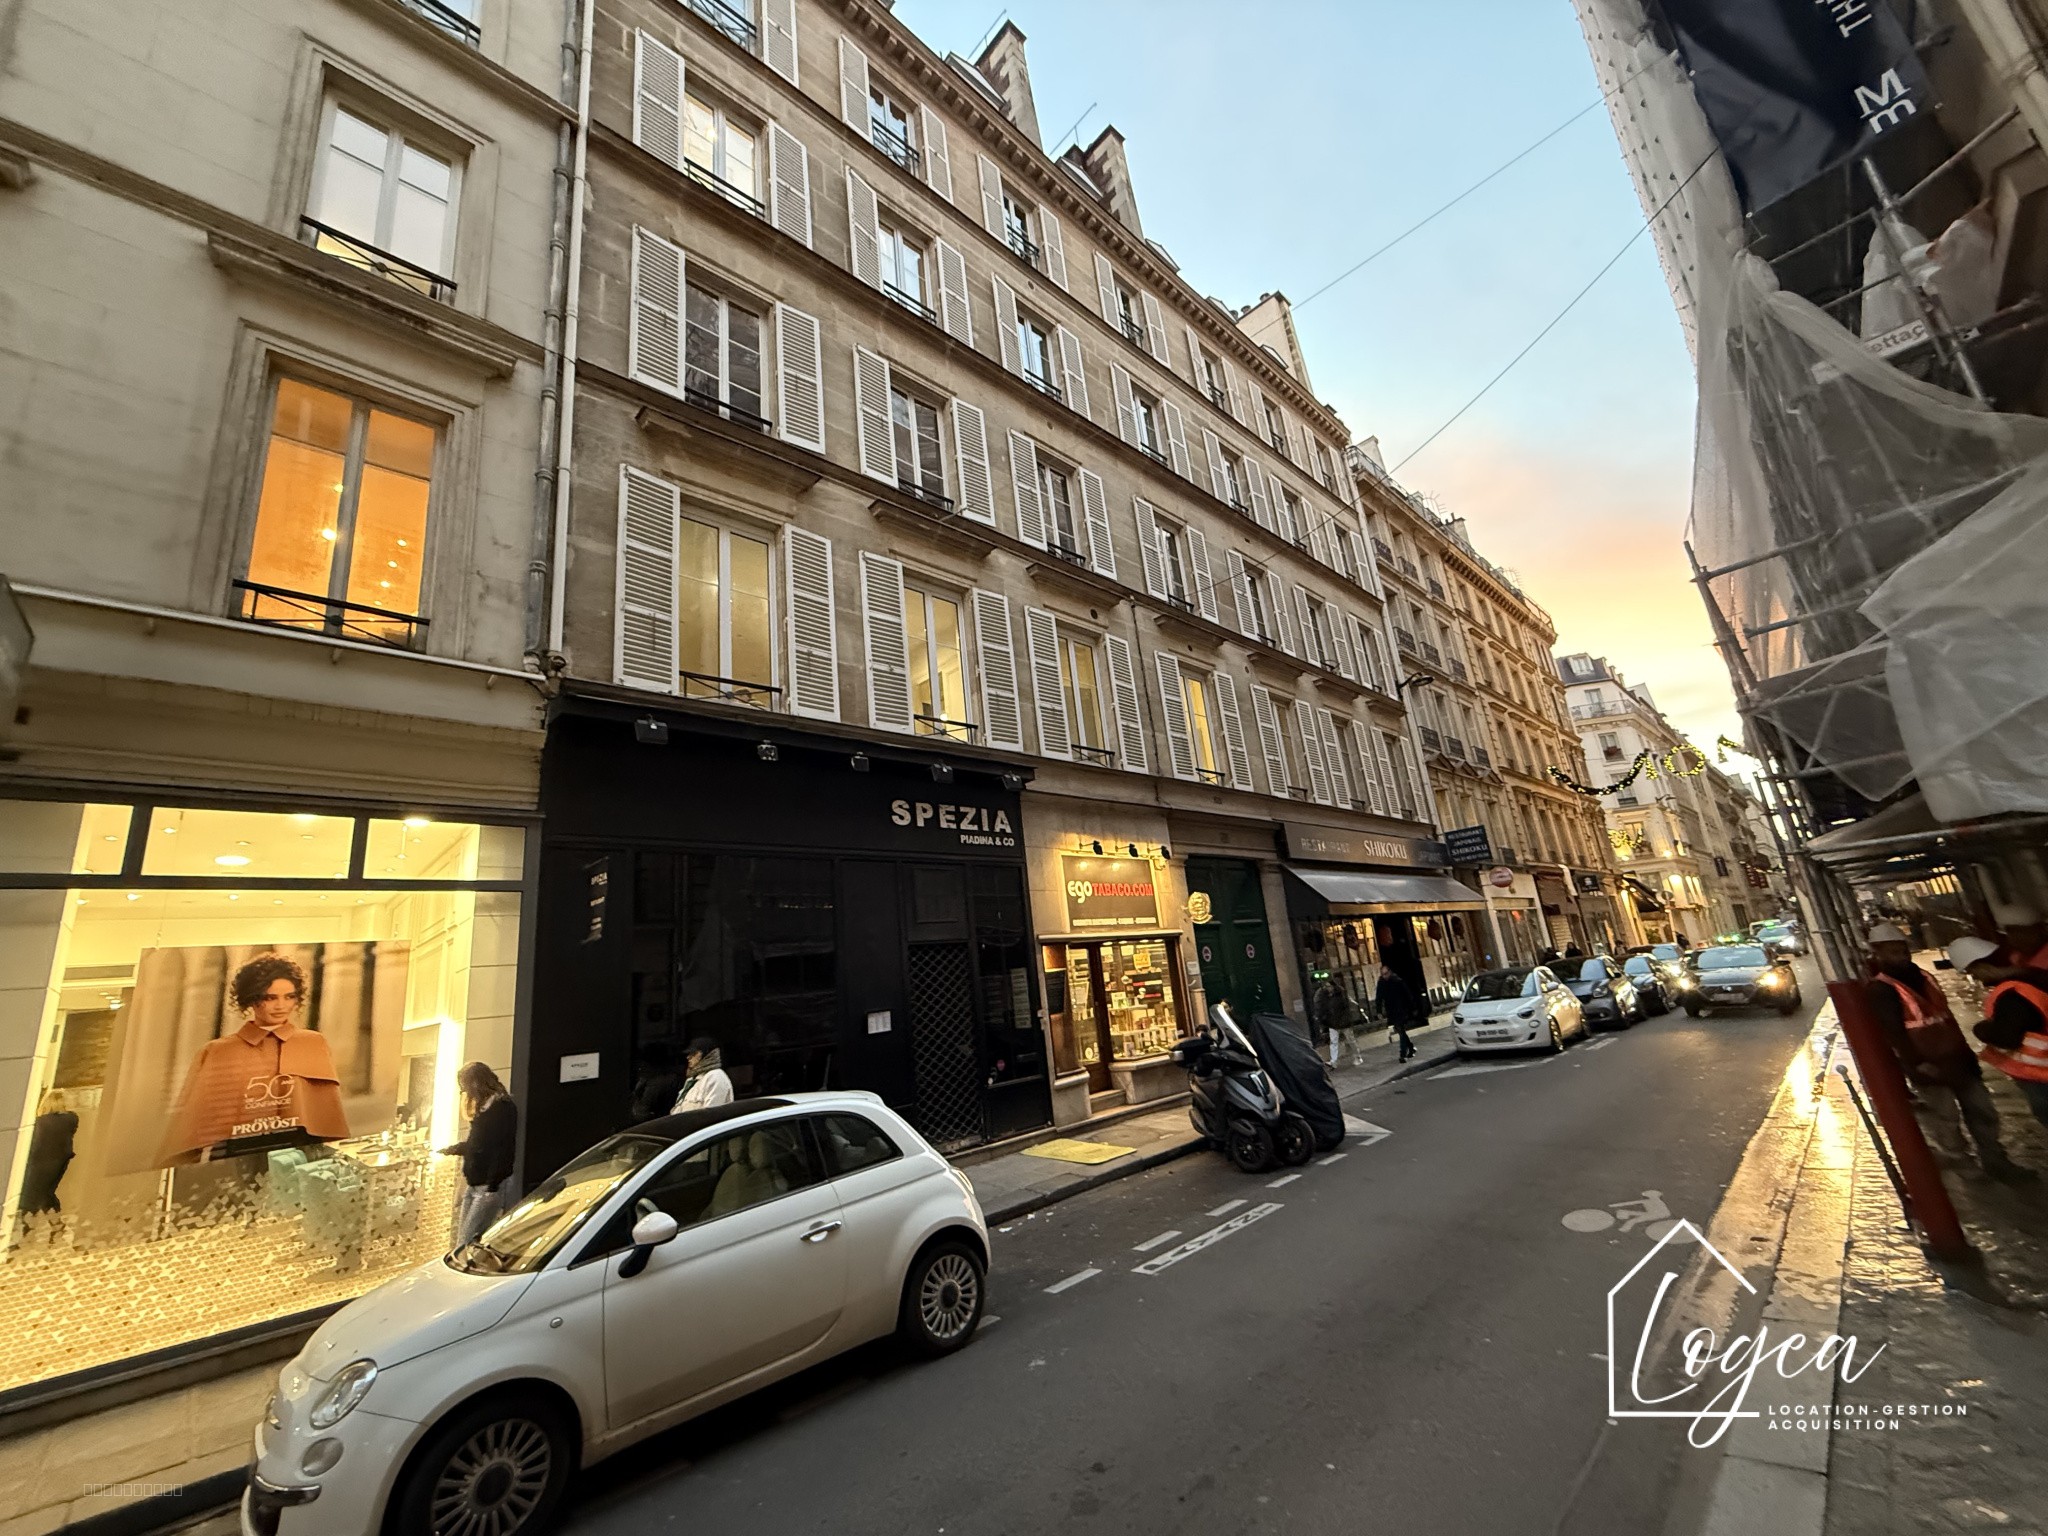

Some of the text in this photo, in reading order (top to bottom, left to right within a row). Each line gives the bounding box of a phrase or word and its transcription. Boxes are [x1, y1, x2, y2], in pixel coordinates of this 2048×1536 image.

[890, 799, 1013, 834] SPEZIA
[960, 834, 995, 846] PIADINA
[1003, 837, 1015, 847] CO
[1363, 839, 1408, 860] SHIKOKU
[1451, 844, 1488, 856] SHIKOKU
[231, 1116, 300, 1136] PROVOST
